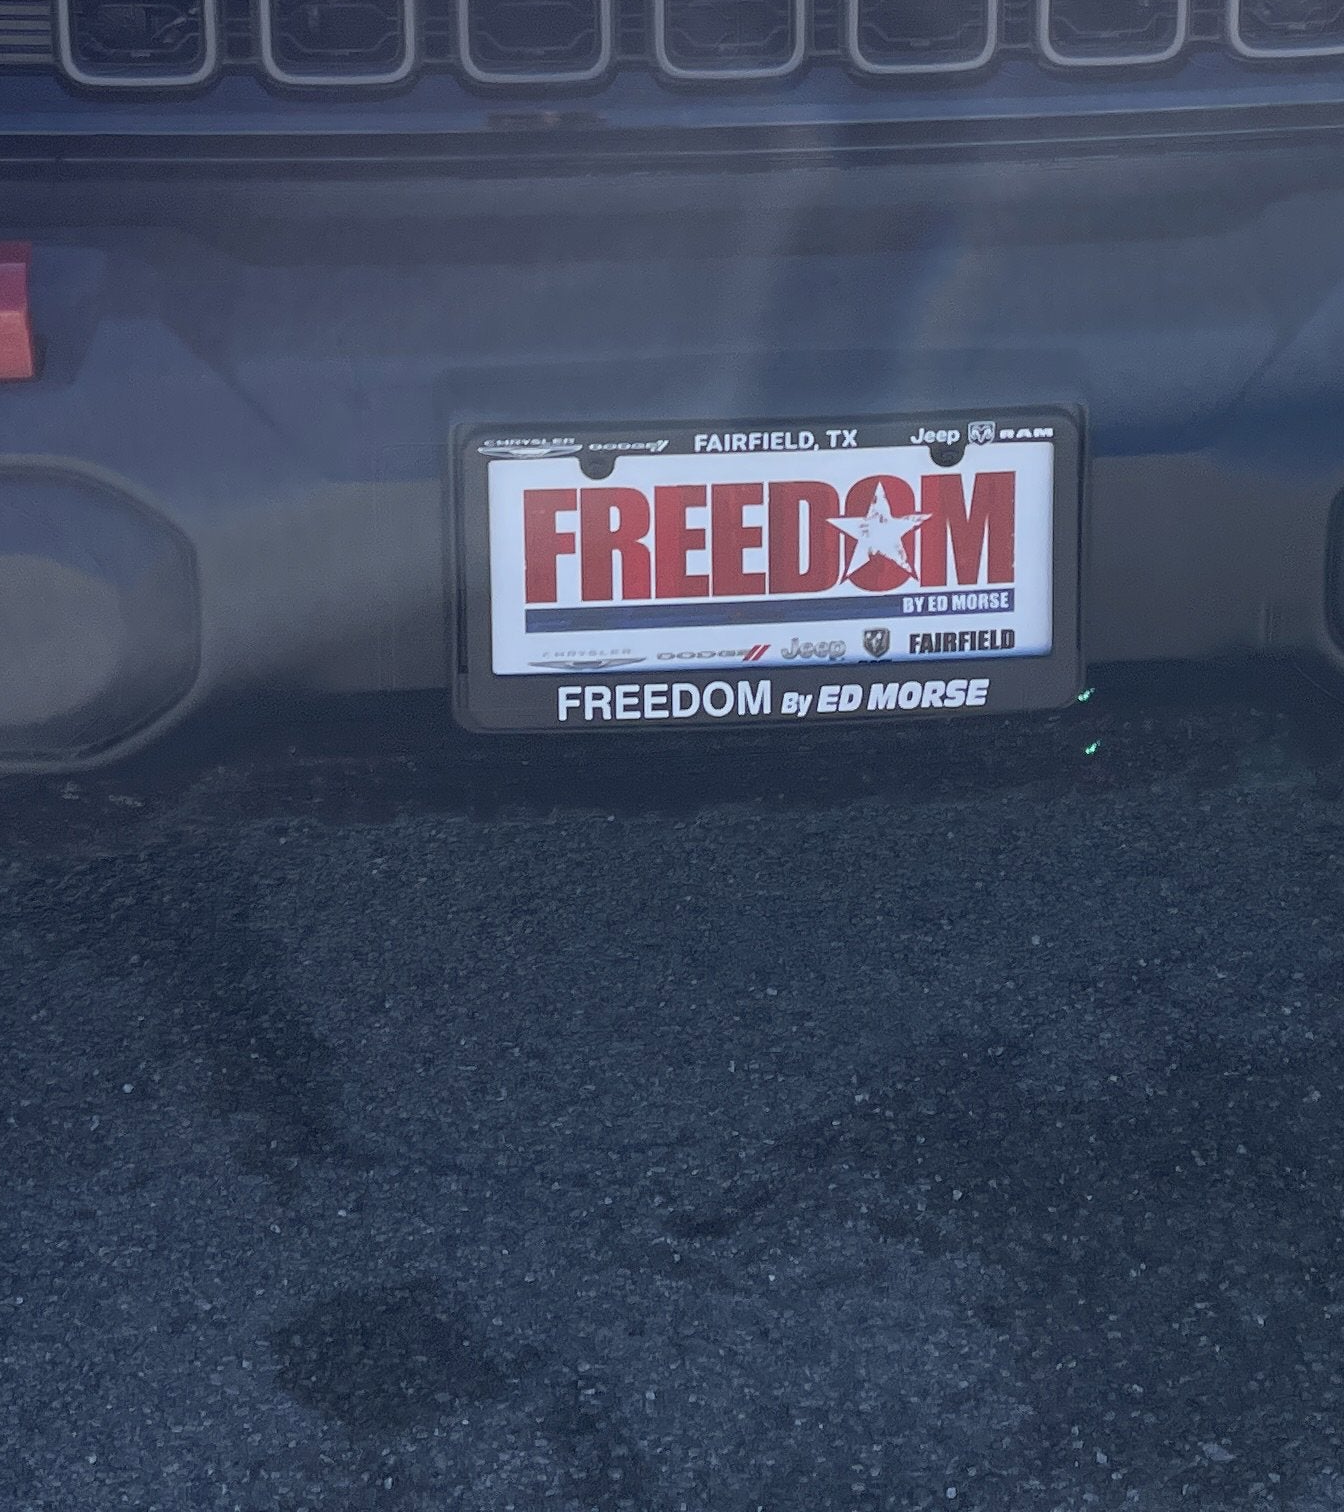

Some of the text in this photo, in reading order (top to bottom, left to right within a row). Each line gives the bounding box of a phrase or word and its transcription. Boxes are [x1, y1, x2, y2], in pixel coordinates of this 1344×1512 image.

[694, 429, 858, 452] FAIRFIELD, TX
[910, 428, 960, 446] Jeep
[999, 427, 1054, 439] RAM
[523, 471, 1016, 603] FREEDOM
[902, 591, 1010, 613] BY ED MORSE
[781, 638, 847, 660] Jeep
[909, 629, 1015, 654] FAIRFIELD
[557, 679, 990, 721] FREEDOM By ED MORSE
